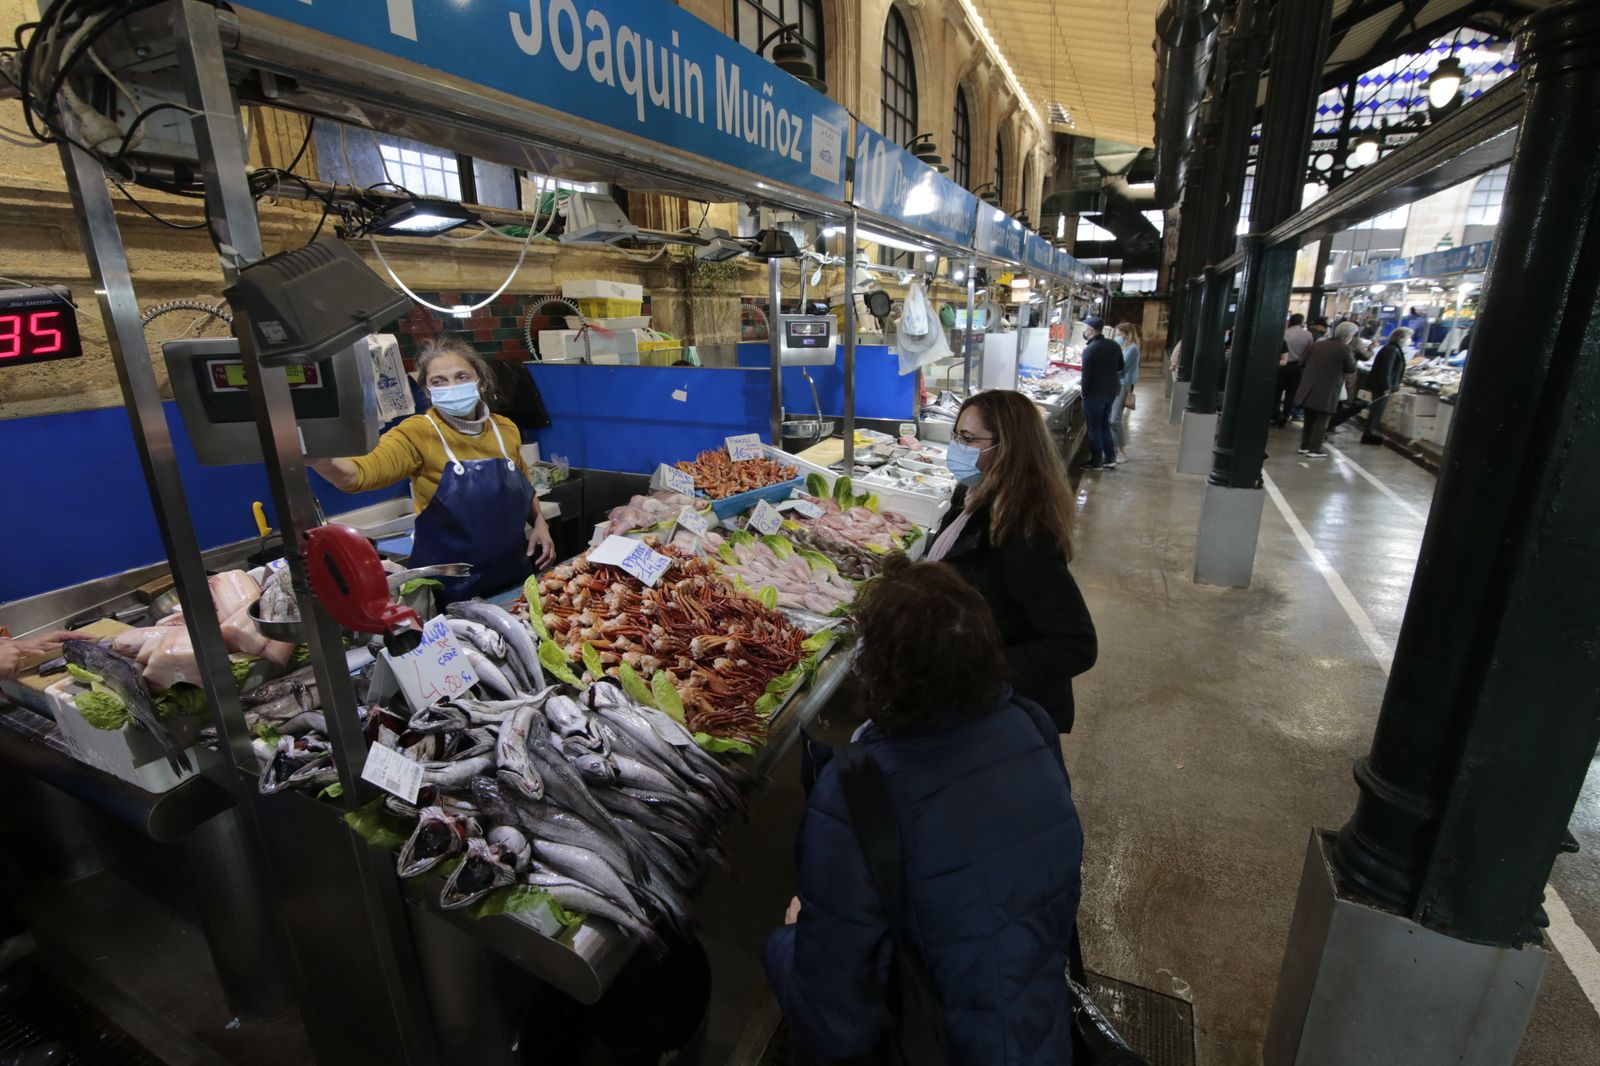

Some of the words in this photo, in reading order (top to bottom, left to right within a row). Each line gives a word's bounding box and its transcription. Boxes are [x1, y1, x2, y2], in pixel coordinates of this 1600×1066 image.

[509, 0, 704, 124] Joaquin
[715, 54, 802, 162] Muñoz
[857, 131, 887, 209] 10
